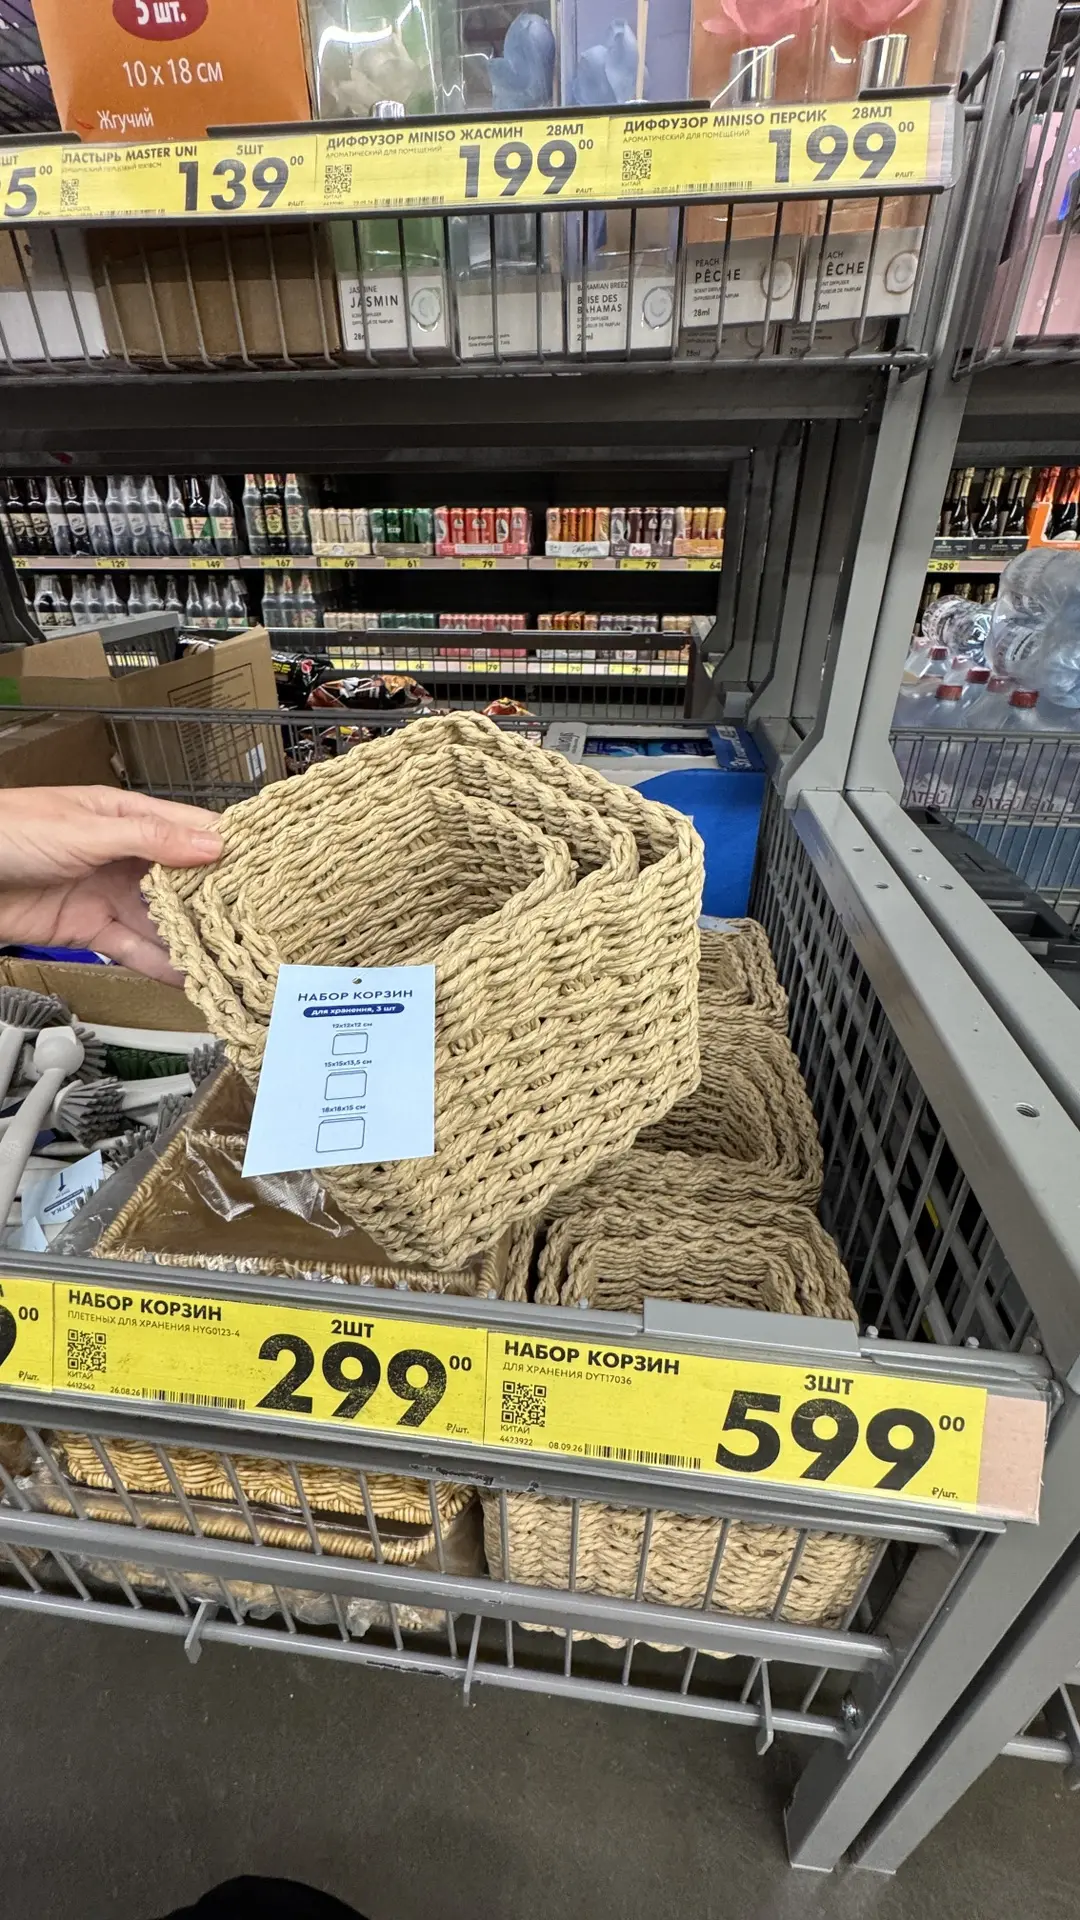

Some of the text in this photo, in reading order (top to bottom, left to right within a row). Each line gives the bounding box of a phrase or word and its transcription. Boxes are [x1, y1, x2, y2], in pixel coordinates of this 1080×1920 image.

[136, 0, 187, 25] 5 шт.
[123, 61, 147, 87] 10
[168, 58, 192, 84] 18
[197, 61, 223, 83] см
[97, 108, 154, 131] Жгучий
[852, 106, 892, 120] 28МЛ
[623, 109, 827, 134] ДИФФУЗОР MINISO ПЕРСИК
[898, 121, 915, 133] 00
[546, 124, 584, 136] 28МЛ
[623, 129, 750, 144] АРОМАТИЧЕСКИЙ ДЛЯ ПОМЕЩЕНИЙ
[326, 127, 523, 150] ДИФФУЗОР MINISO ЖАСМИН
[578, 139, 593, 150] 00
[62, 145, 197, 164] ЛАСТЫРЬ MASTER UNI
[236, 145, 264, 156] 5ШТ
[325, 145, 442, 159] АРОМАТИЧЕСКИЙ ДЛЯ ПОМЕЩЕНИЙ
[768, 121, 897, 183] 199
[2, 155, 19, 166] ШТ
[290, 156, 304, 166] 00
[39, 165, 52, 176] 00
[459, 139, 577, 198] 199
[179, 156, 289, 211] 139
[3, 167, 37, 217] 5
[827, 251, 844, 260] ACH
[695, 258, 720, 267] PEACH
[826, 261, 864, 276] ÊCHE
[577, 281, 629, 291] BAMIAN BREEZ
[577, 294, 618, 305] BISE DES
[577, 304, 622, 314] BHAMAS
[693, 308, 710, 317] 28ml
[577, 333, 593, 341] 2ml
[16, 560, 26, 568] 29
[111, 560, 125, 568] 129
[206, 560, 220, 568] 149
[276, 559, 290, 567] 167
[344, 560, 354, 568] 69
[407, 560, 417, 568] 61
[578, 561, 589, 569] 79
[936, 562, 954, 571] 389
[298, 989, 413, 1002] НАБОР КОРЗИН
[311, 1006, 328, 1016] для
[329, 1006, 375, 1016] хранения,
[69, 1289, 222, 1322] НАБОР КОРЗИН
[18, 1306, 39, 1321] 00
[67, 1310, 240, 1338] ПЛЕТЕНЫХ ДЛЯ ХРАНЕНИЯ HYG0123-4
[331, 1320, 374, 1338] 2ШТ
[449, 1355, 472, 1371] 00
[504, 1340, 680, 1375] НАБОР КОРЗИН
[67, 1370, 94, 1379] КИТАЙ
[255, 1333, 447, 1427] 299
[502, 1362, 632, 1385] ДЛЯ ХРАНЕНИЯ DYT17036
[804, 1374, 854, 1395] 3ШТ
[110, 1386, 141, 1397] 26.08.26
[500, 1424, 530, 1434] КИТАЙ
[939, 1414, 965, 1432] 00
[500, 1435, 582, 1453] 4423922 08.09.26
[715, 1390, 935, 1491] 599
